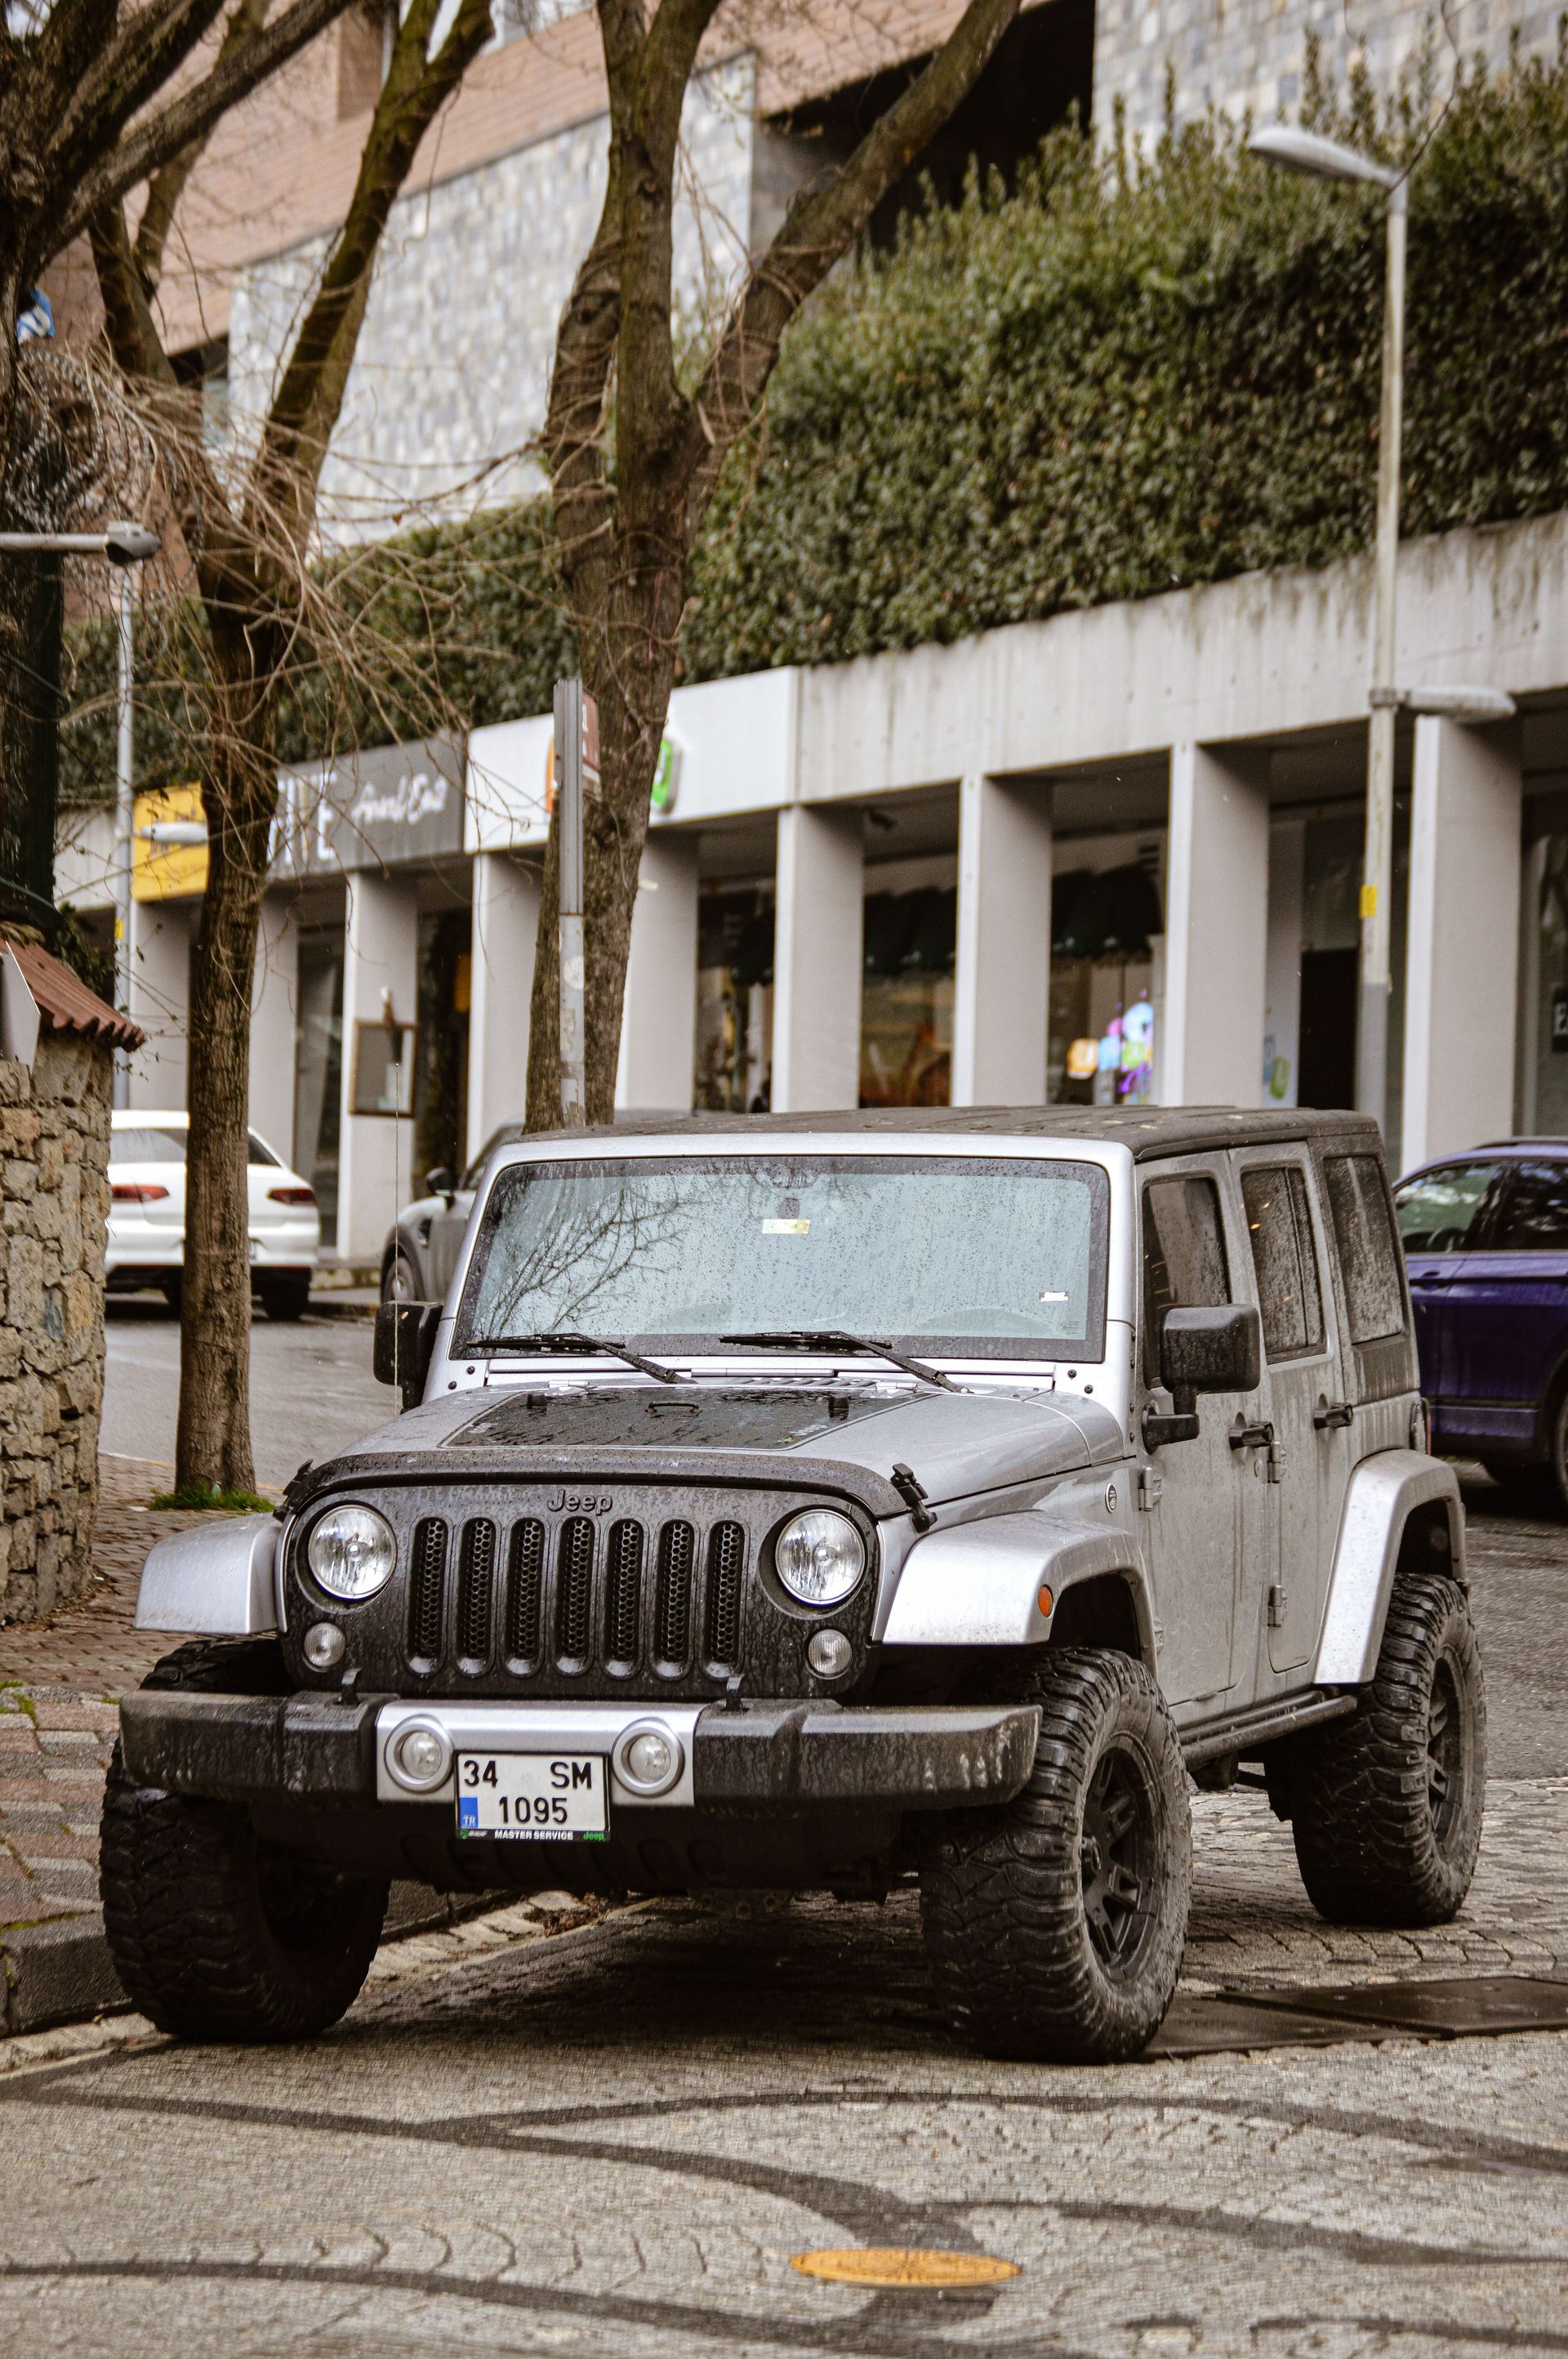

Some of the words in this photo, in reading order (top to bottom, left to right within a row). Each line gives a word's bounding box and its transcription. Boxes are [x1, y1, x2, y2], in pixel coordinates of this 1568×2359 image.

[546, 1489, 612, 1516] Jeep
[464, 1759, 497, 1787] 34
[550, 1761, 591, 1789] SM
[463, 1815, 476, 1826] TR
[499, 1796, 568, 1824] 1095
[494, 1829, 532, 1839] MASTER
[533, 1830, 573, 1840] SERVICE
